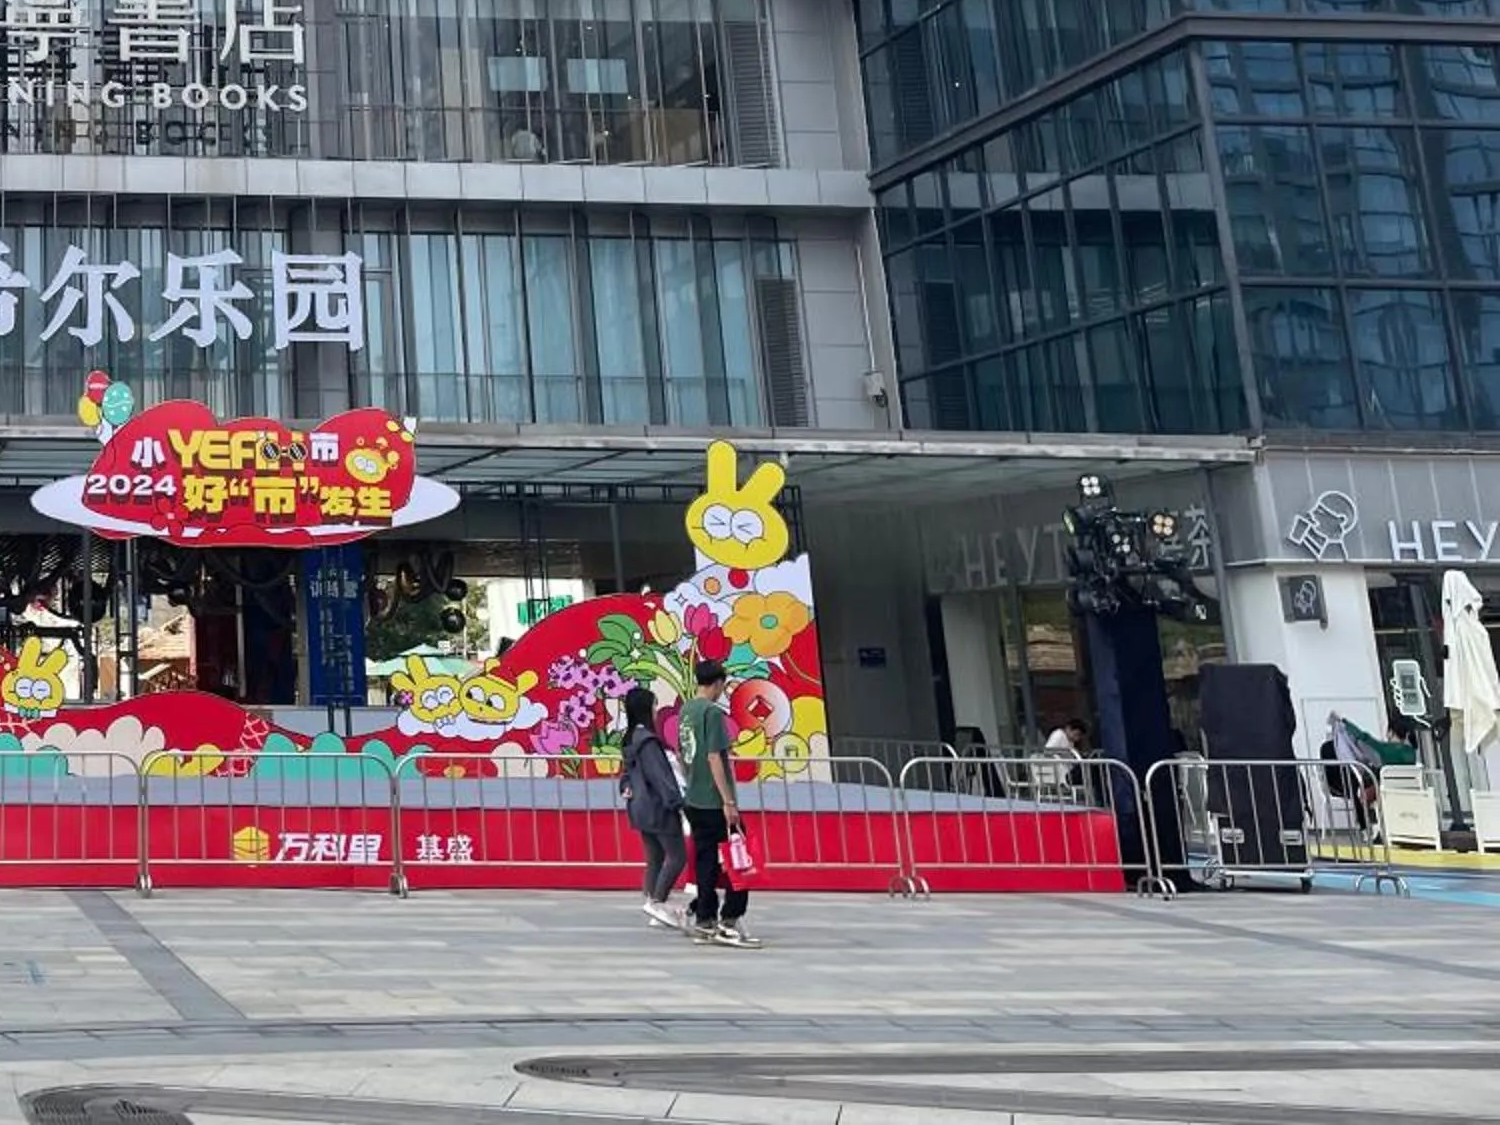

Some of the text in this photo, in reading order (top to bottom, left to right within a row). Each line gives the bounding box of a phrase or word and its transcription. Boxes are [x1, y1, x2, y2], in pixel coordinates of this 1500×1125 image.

[153, 82, 309, 113] BOOKS
[87, 474, 177, 496] 2024
[274, 832, 474, 863] 万科里 基盛
